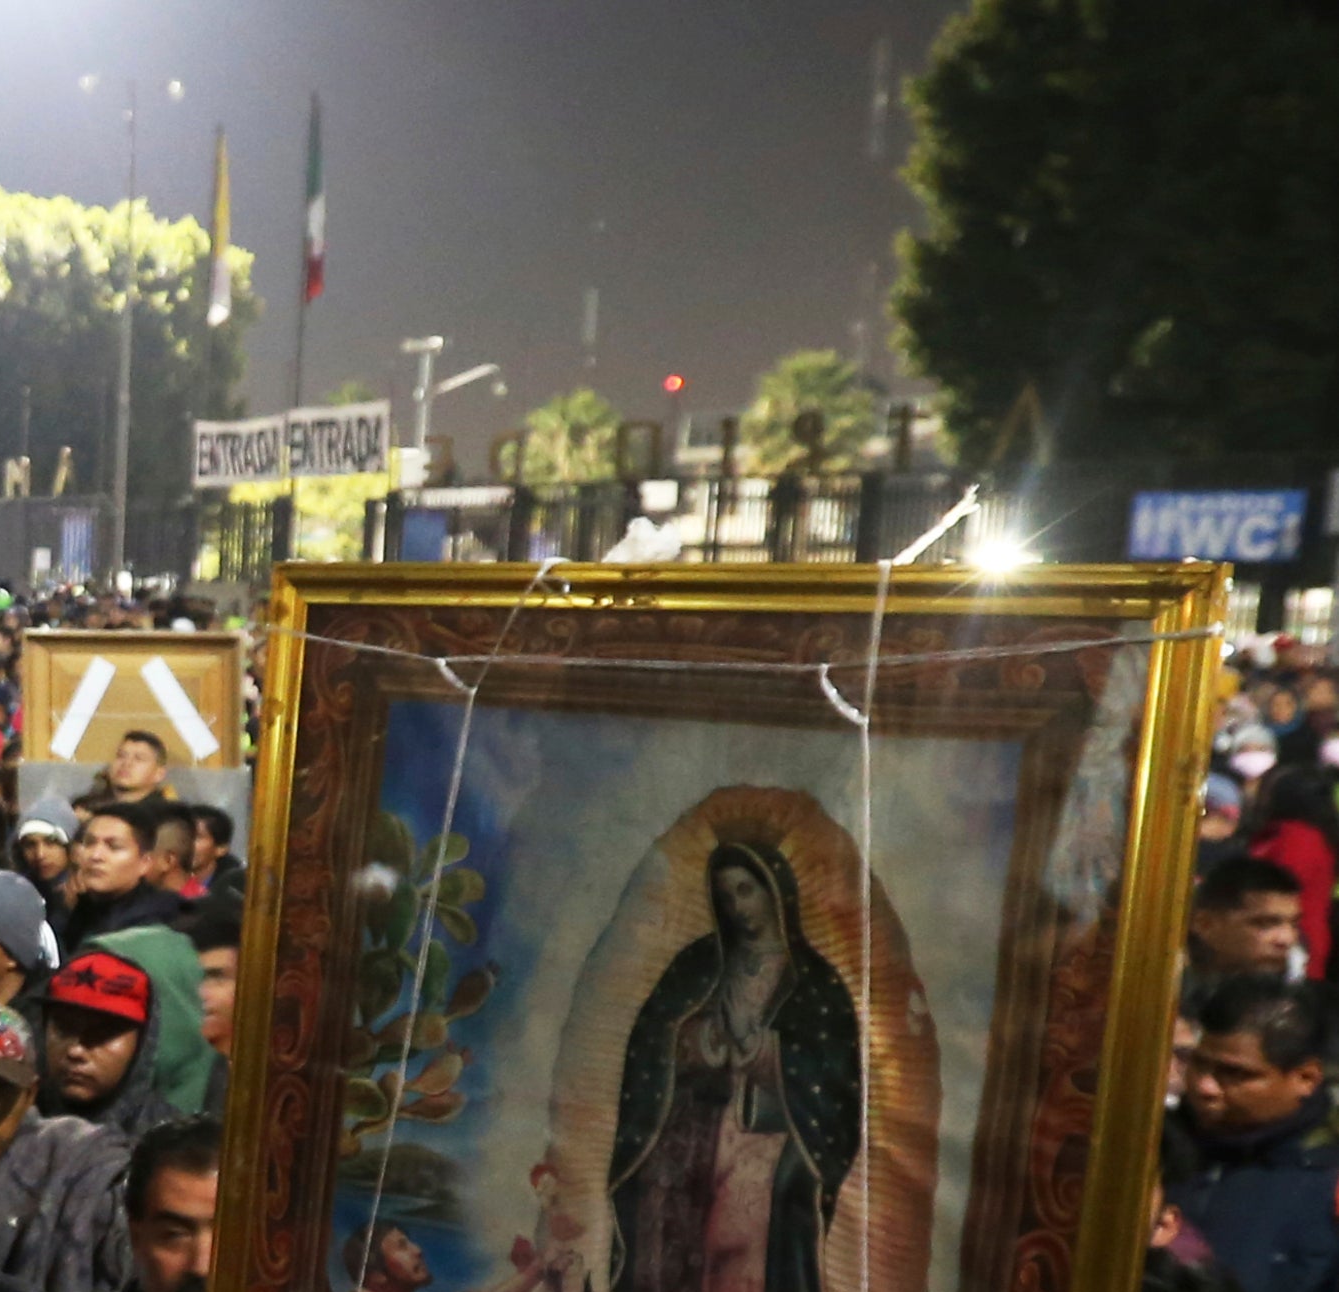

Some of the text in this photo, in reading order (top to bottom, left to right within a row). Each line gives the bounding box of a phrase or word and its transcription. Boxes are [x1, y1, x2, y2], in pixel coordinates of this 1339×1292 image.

[198, 429, 279, 476] ENTRADA
[289, 414, 382, 473] ENTRADA
[1178, 513, 1278, 561] WC
